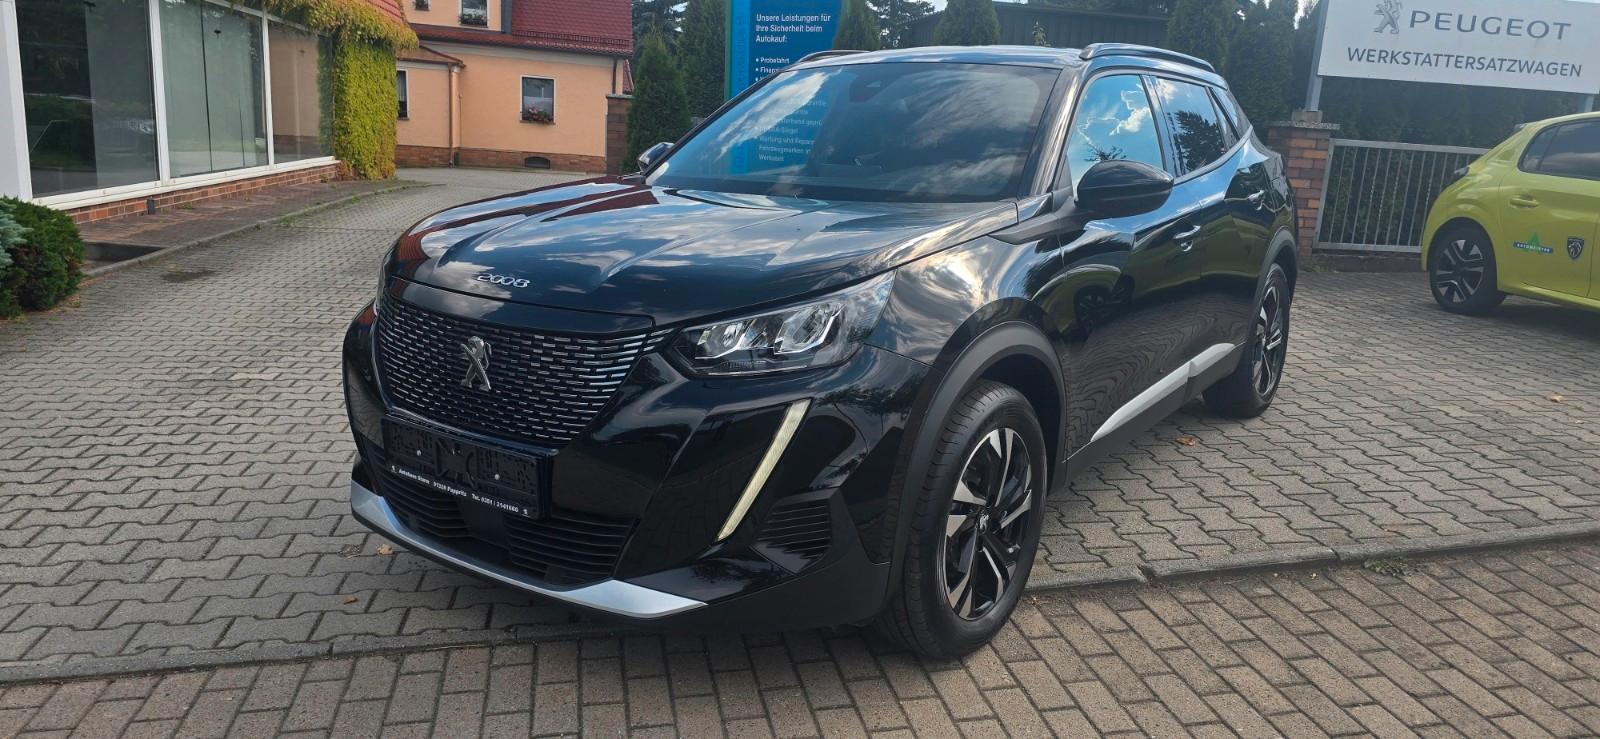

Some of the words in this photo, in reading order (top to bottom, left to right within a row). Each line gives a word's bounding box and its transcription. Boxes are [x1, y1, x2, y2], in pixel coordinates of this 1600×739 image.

[756, 13, 779, 22] Unsere
[781, 13, 819, 23] Leistungen
[820, 13, 831, 22] für
[1409, 10, 1571, 40] PEUGEOT
[756, 24, 769, 32] Ihre
[770, 24, 804, 32] Sicherheit
[805, 24, 823, 32] beim
[1347, 47, 1583, 78] WERKSTATTERSATZWAGEN
[477, 273, 530, 287] 2008
